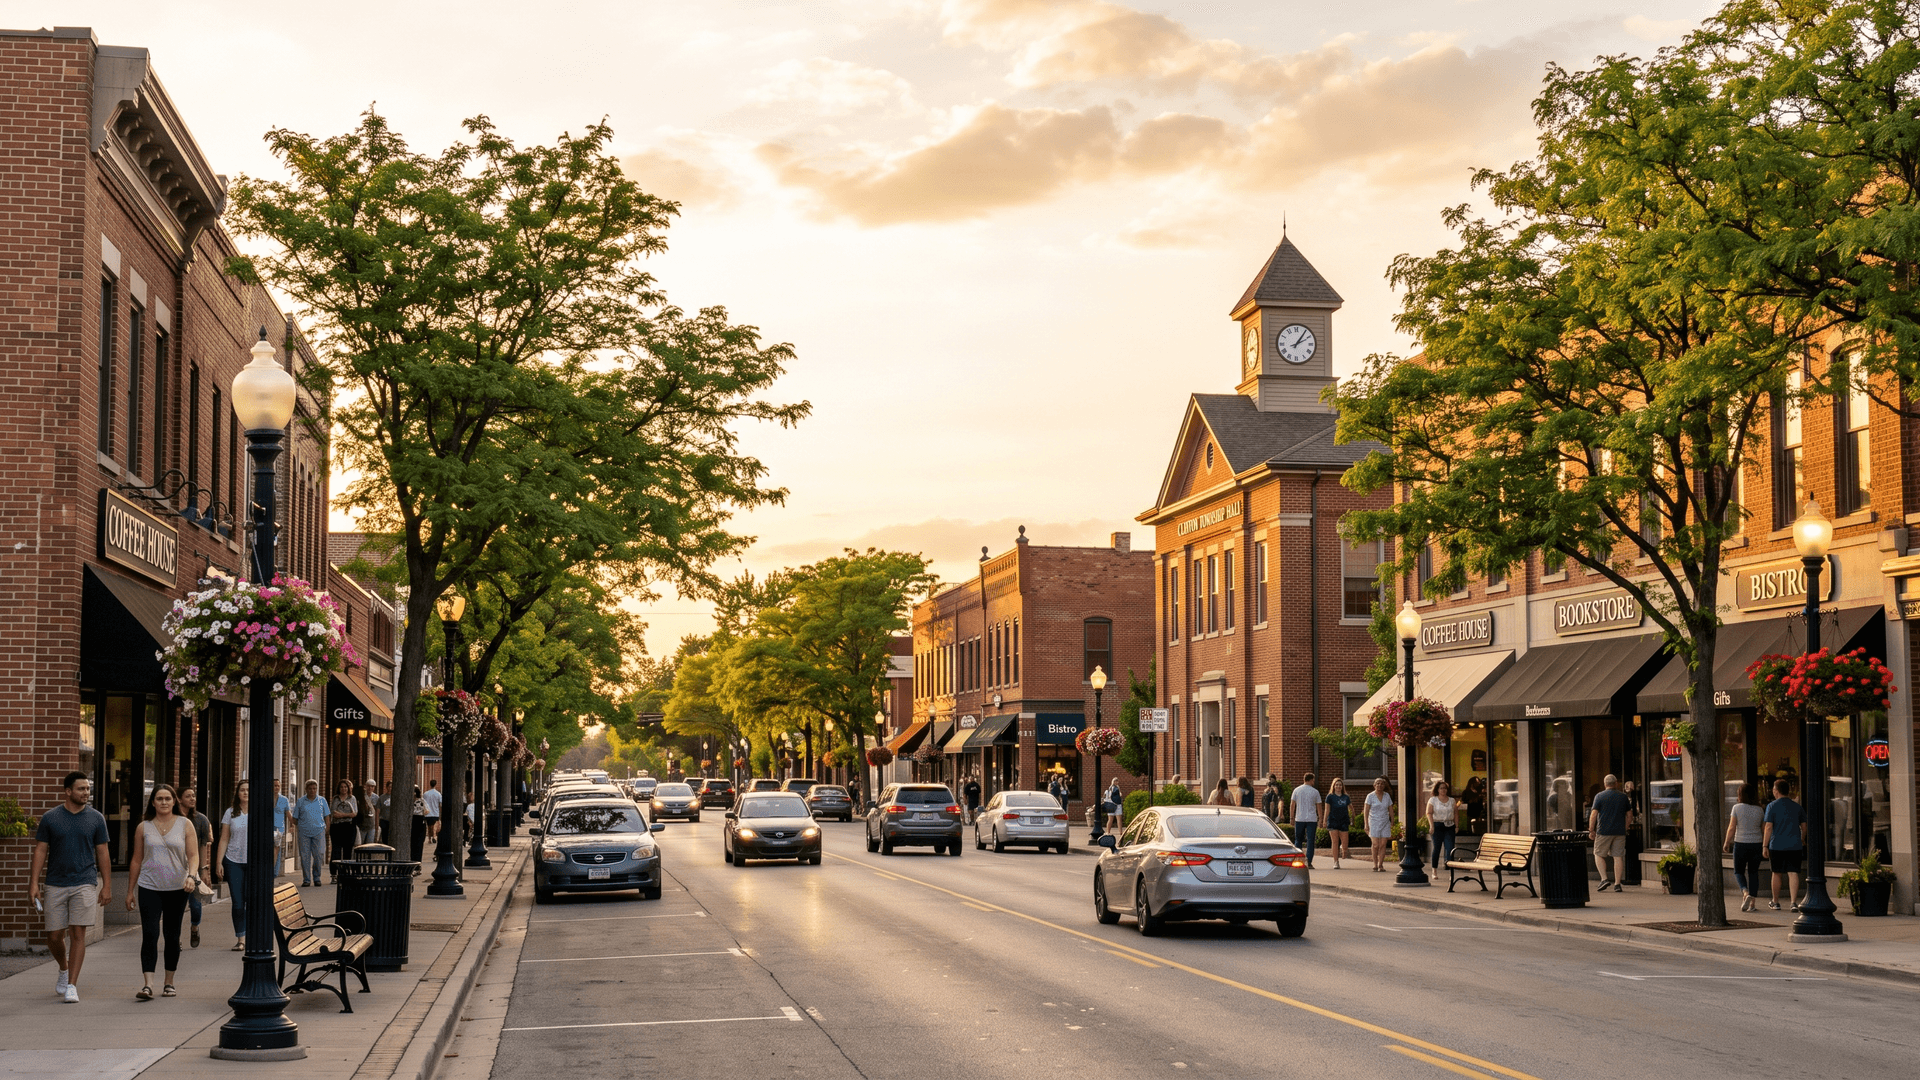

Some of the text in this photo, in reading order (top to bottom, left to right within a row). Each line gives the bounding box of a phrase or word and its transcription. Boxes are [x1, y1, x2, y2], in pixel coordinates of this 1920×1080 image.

[108, 504, 176, 575] COFFEE HOUSE
[1558, 595, 1635, 628] BOOKSTORE
[1422, 618, 1488, 646] COFFEE HOUSE
[333, 707, 365, 720] Gifts
[1048, 723, 1077, 734] Bistro
